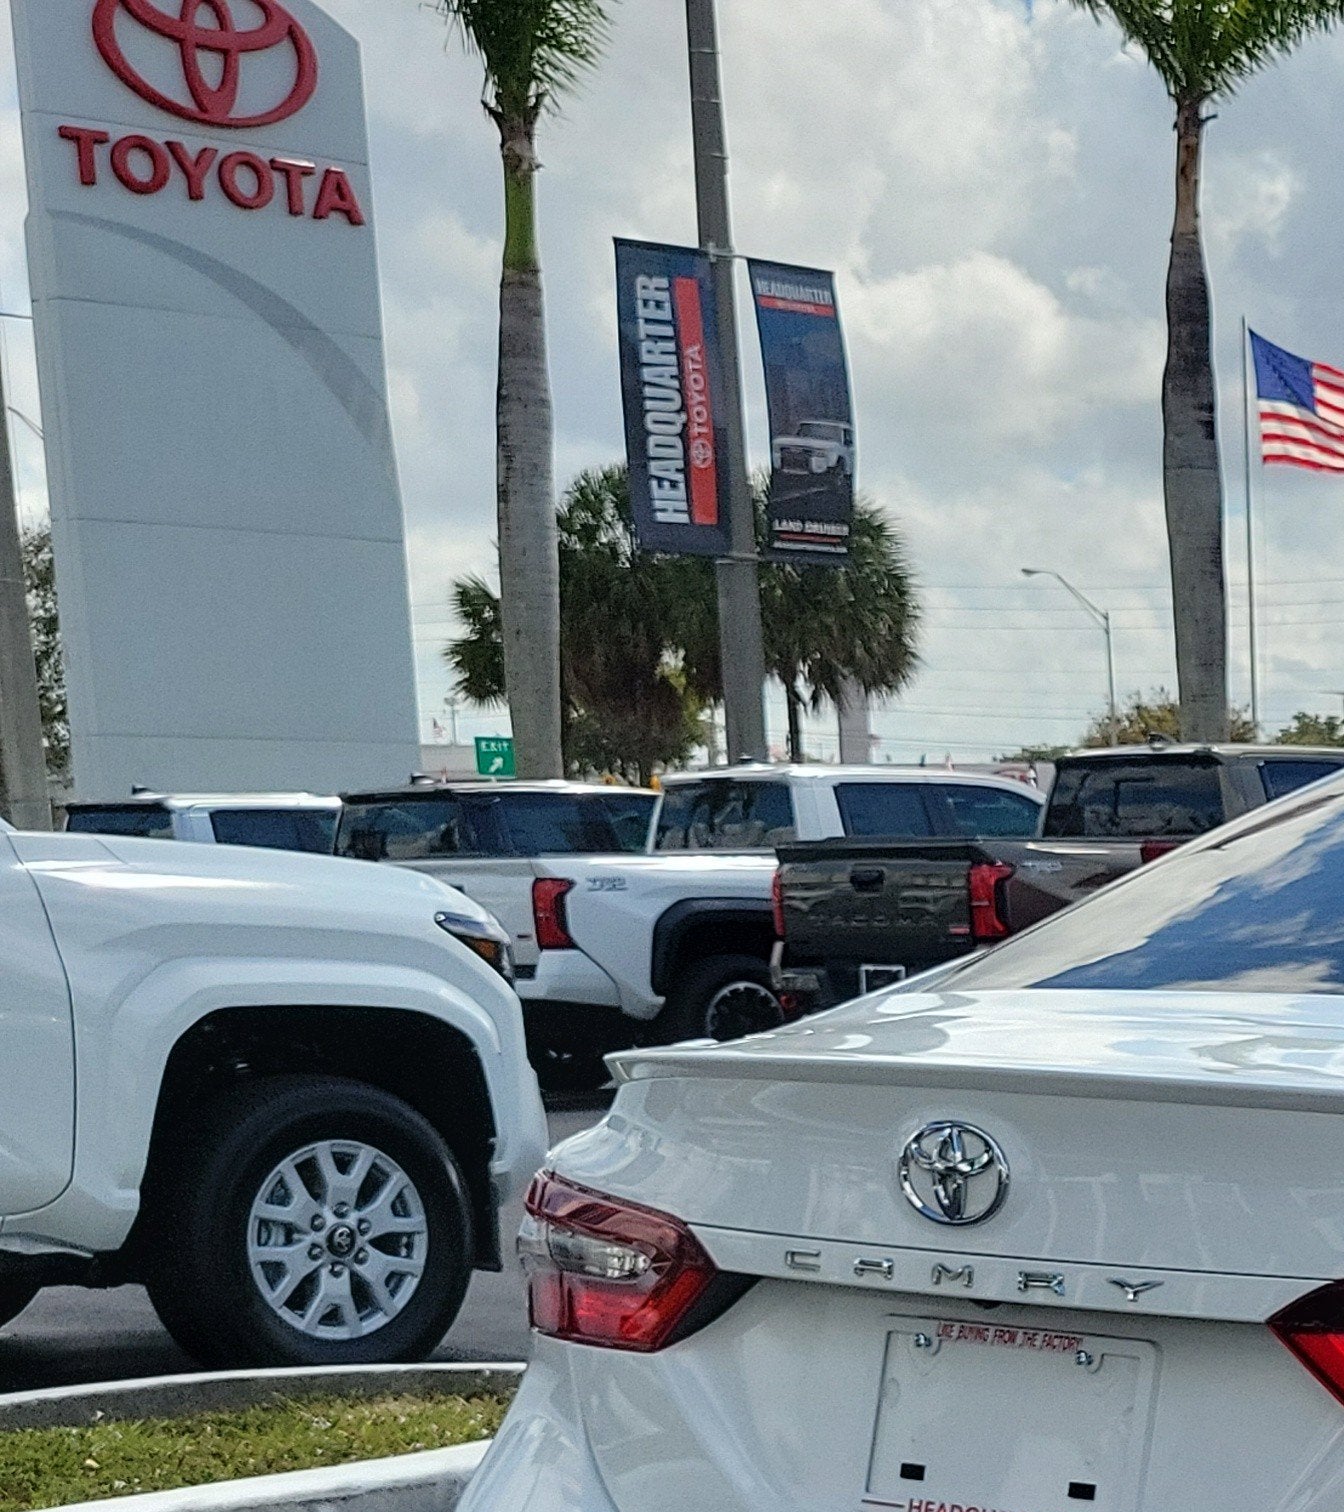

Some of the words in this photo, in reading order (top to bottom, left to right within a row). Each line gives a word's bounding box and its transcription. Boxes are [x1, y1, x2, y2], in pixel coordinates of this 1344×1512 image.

[57, 124, 365, 226] TOYOTA
[635, 274, 691, 525] HEADQUARTER
[684, 344, 711, 434] TOYOTA
[480, 740, 510, 752] EXIT
[784, 1247, 1166, 1302] CAMRY
